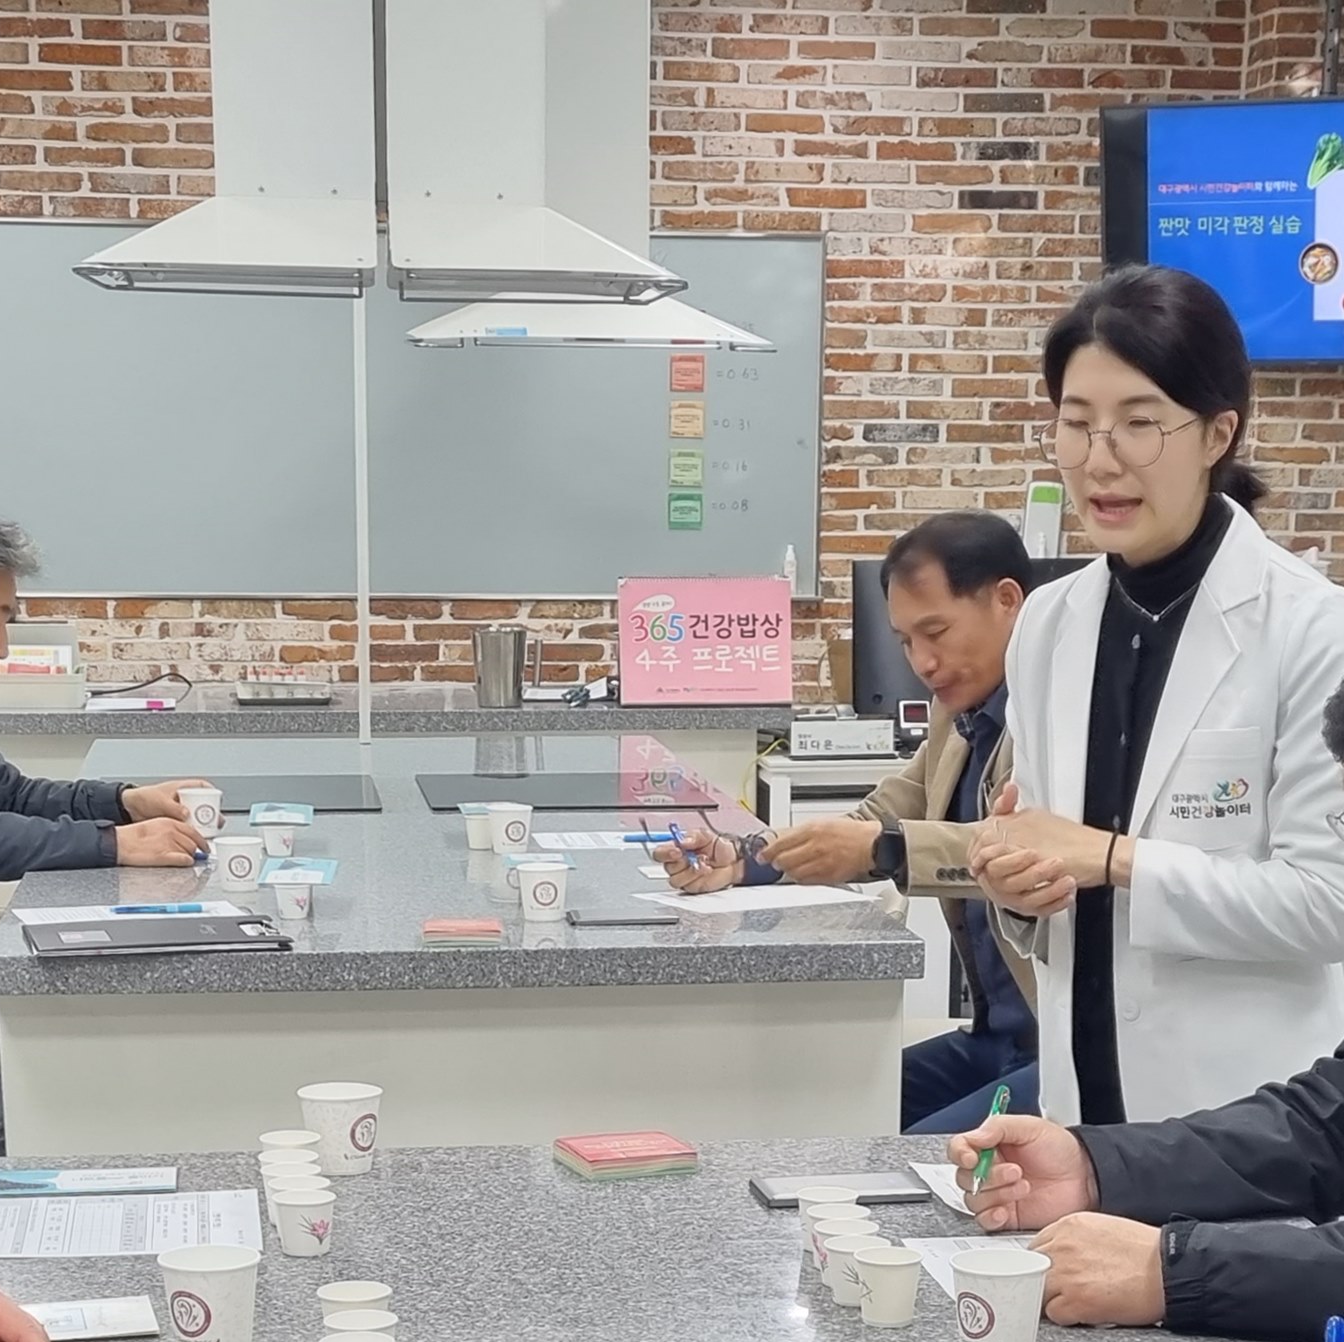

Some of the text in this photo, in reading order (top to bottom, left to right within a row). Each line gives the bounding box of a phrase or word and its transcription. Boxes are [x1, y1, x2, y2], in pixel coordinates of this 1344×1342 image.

[1158, 215, 1302, 237] 짠맛 미각 판정 실습
[629, 612, 783, 643] 365 건강밥상
[635, 645, 782, 673] 4주 프로젝트
[1172, 793, 1209, 804] 대구광역시
[1169, 802, 1252, 820] 시민건강놀이터
